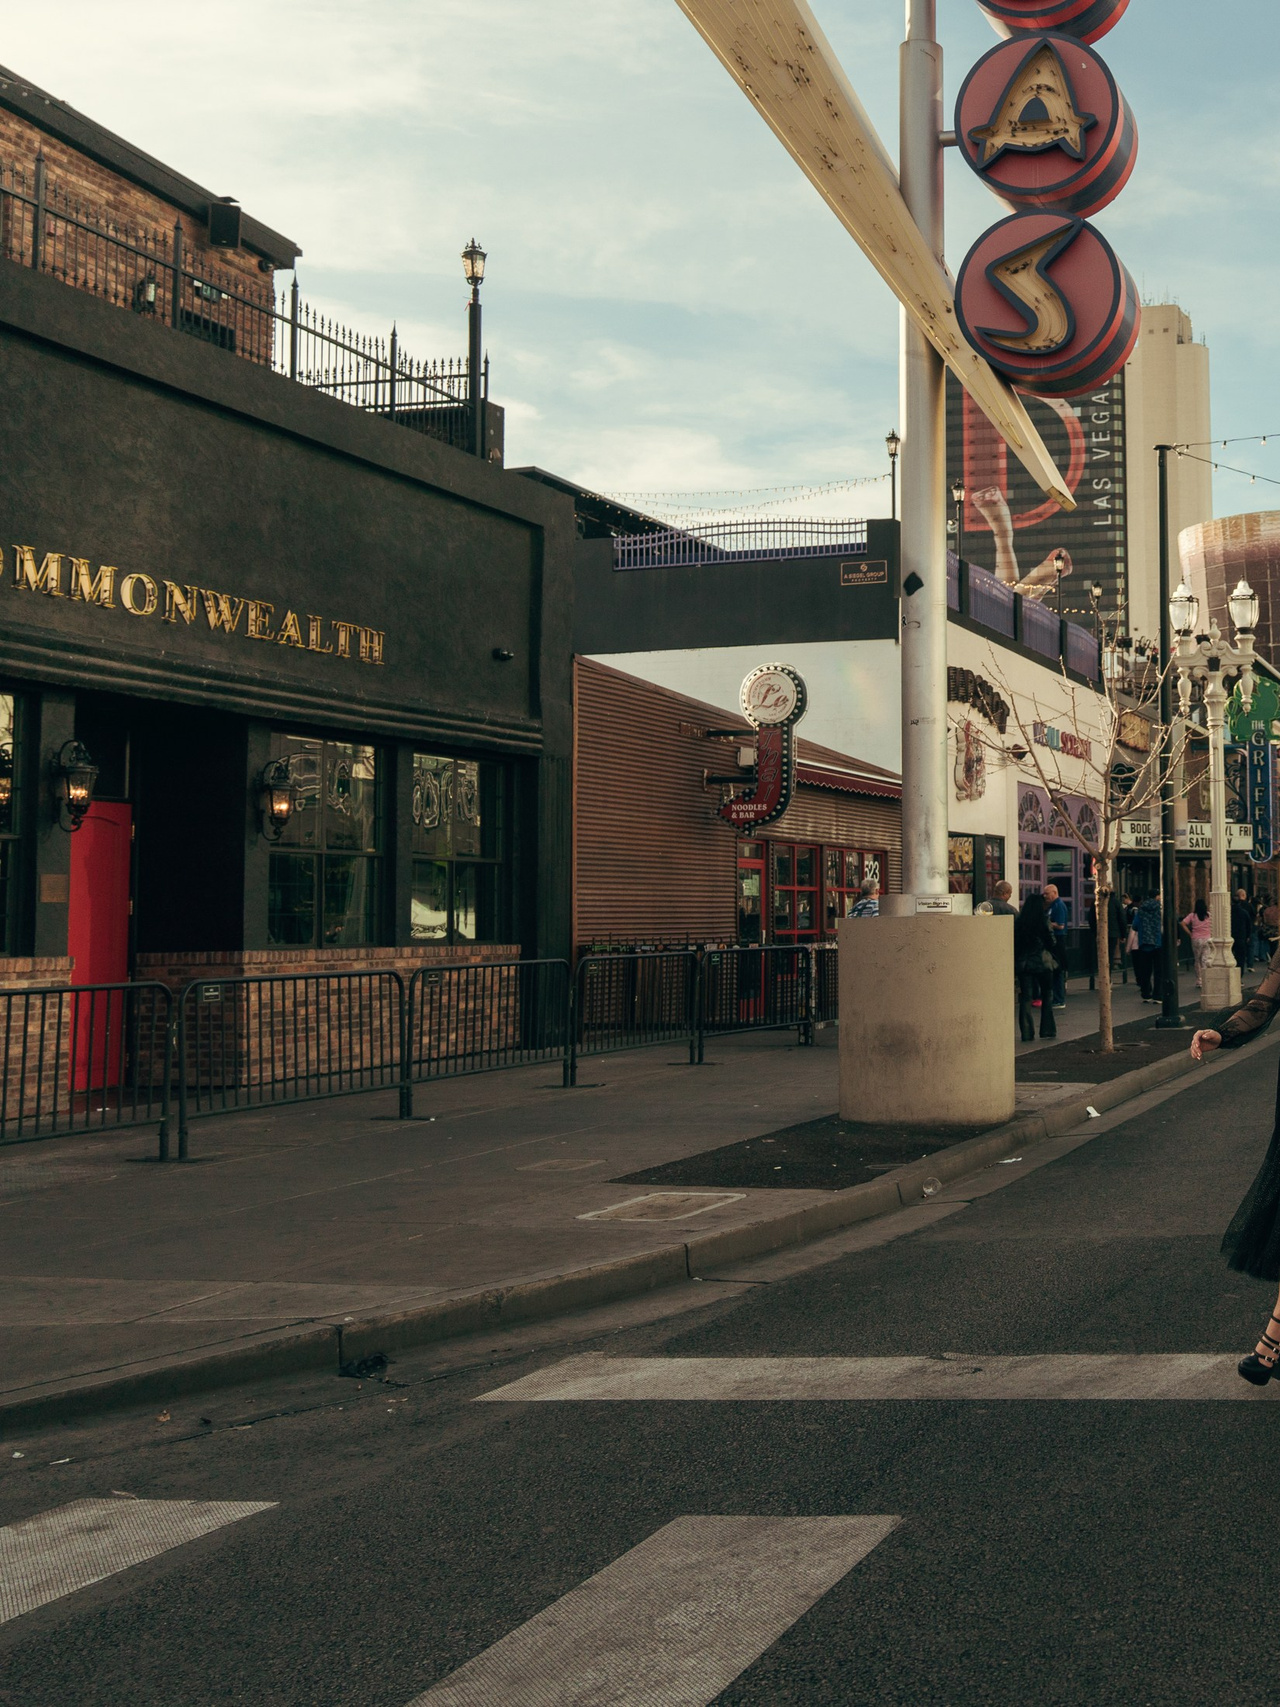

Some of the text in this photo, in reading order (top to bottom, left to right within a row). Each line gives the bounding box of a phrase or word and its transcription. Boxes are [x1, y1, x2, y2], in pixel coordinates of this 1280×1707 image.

[1091, 380, 1112, 526] LAS VEGA
[1251, 720, 1265, 730] THE
[760, 730, 779, 801] Thai
[1250, 731, 1266, 859] GRIFFIN
[1189, 824, 1205, 835] ALL
[864, 860, 880, 883] 523
